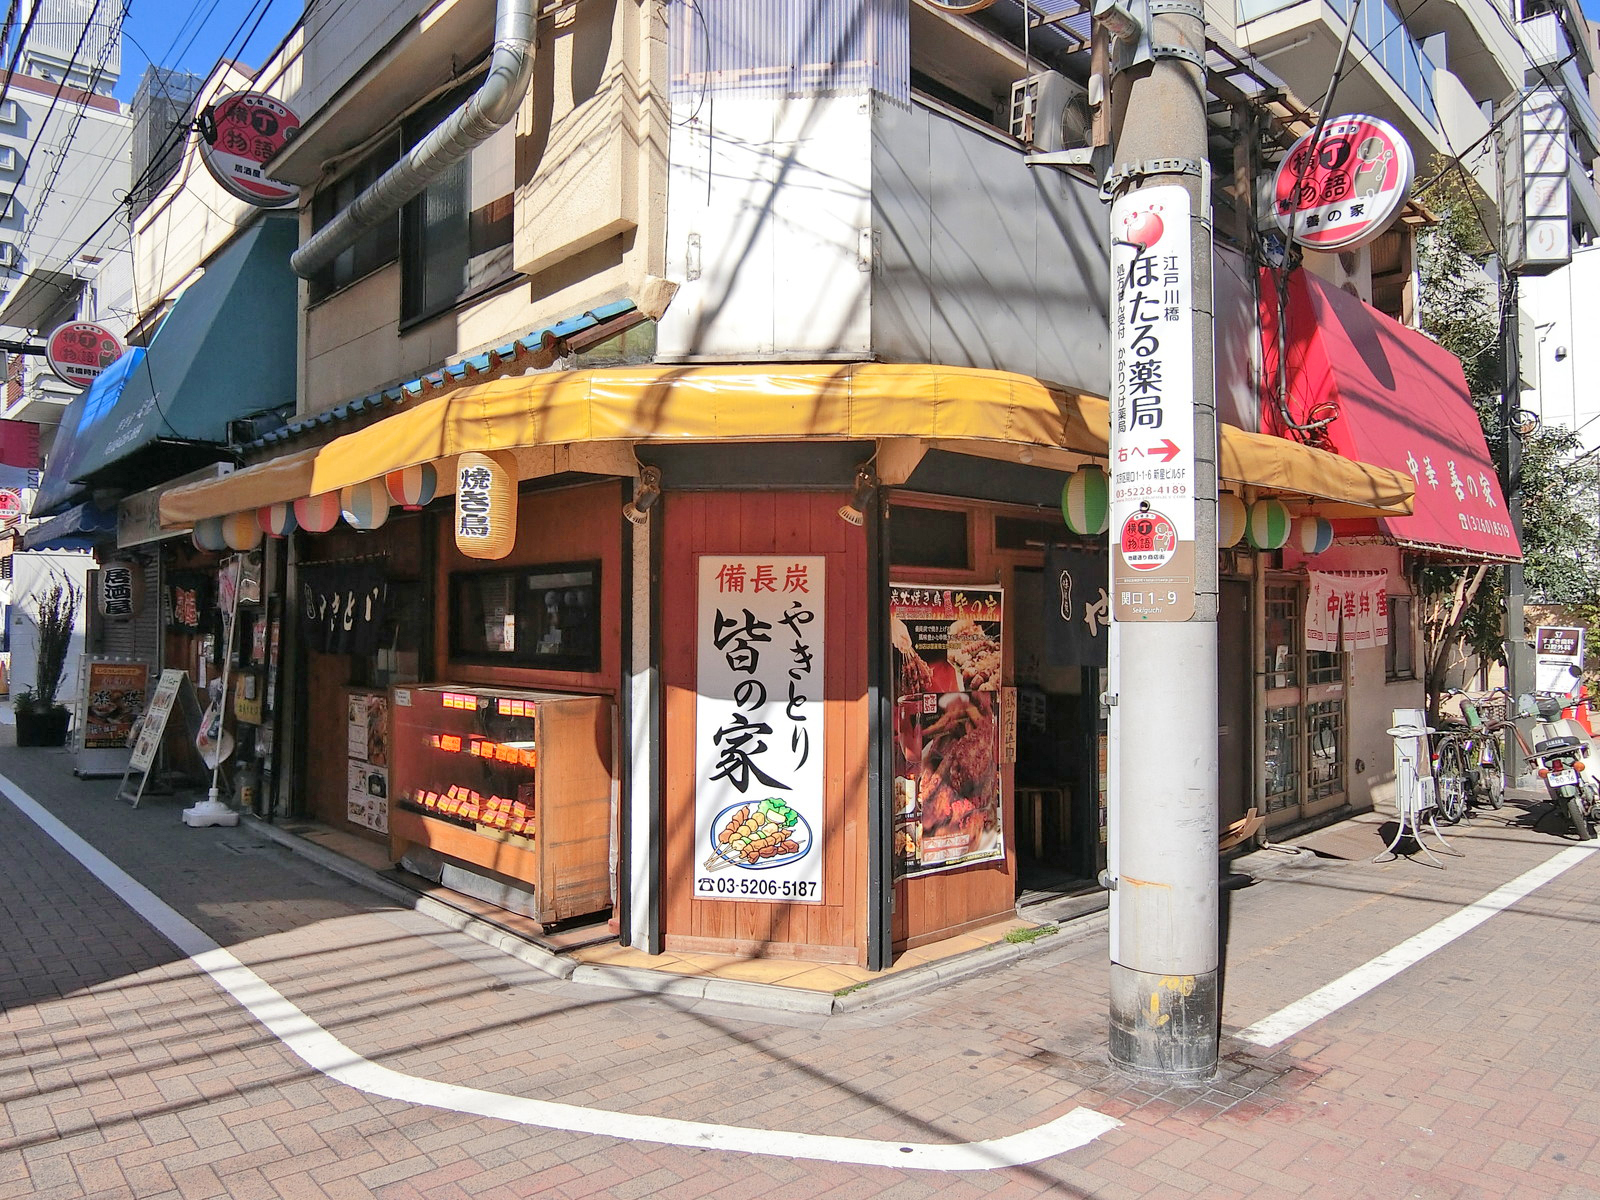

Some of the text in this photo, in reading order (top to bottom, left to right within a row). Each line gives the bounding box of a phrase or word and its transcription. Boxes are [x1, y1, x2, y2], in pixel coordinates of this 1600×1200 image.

[226, 102, 273, 133] 横丁
[226, 130, 276, 160] 物語
[1324, 126, 1358, 138] 蔵通り
[1306, 204, 1365, 229] 善の家
[1163, 256, 1180, 322] 江戸川橋
[1129, 255, 1163, 432] ほたる薬局
[66, 366, 103, 377] 高橋時計
[1117, 347, 1127, 434] かかりつけ薬局
[1117, 446, 1145, 463] 右へ
[1115, 485, 1187, 499] 03-5228-4189
[1405, 450, 1497, 509] 中華 善の家
[460, 467, 491, 537] 焼き鳥
[1127, 521, 1152, 535] 横丁
[1127, 538, 1151, 551] 物語
[104, 568, 133, 616] 居酒屋
[715, 563, 811, 595] 備長炭
[889, 588, 942, 608] 炭火焼き鳥
[1121, 591, 1143, 605] 関口
[1132, 606, 1162, 615] Sekiguchi
[777, 600, 816, 774] やきとり
[708, 608, 794, 794] 皆の家
[716, 878, 817, 899] 03-5206-5187
